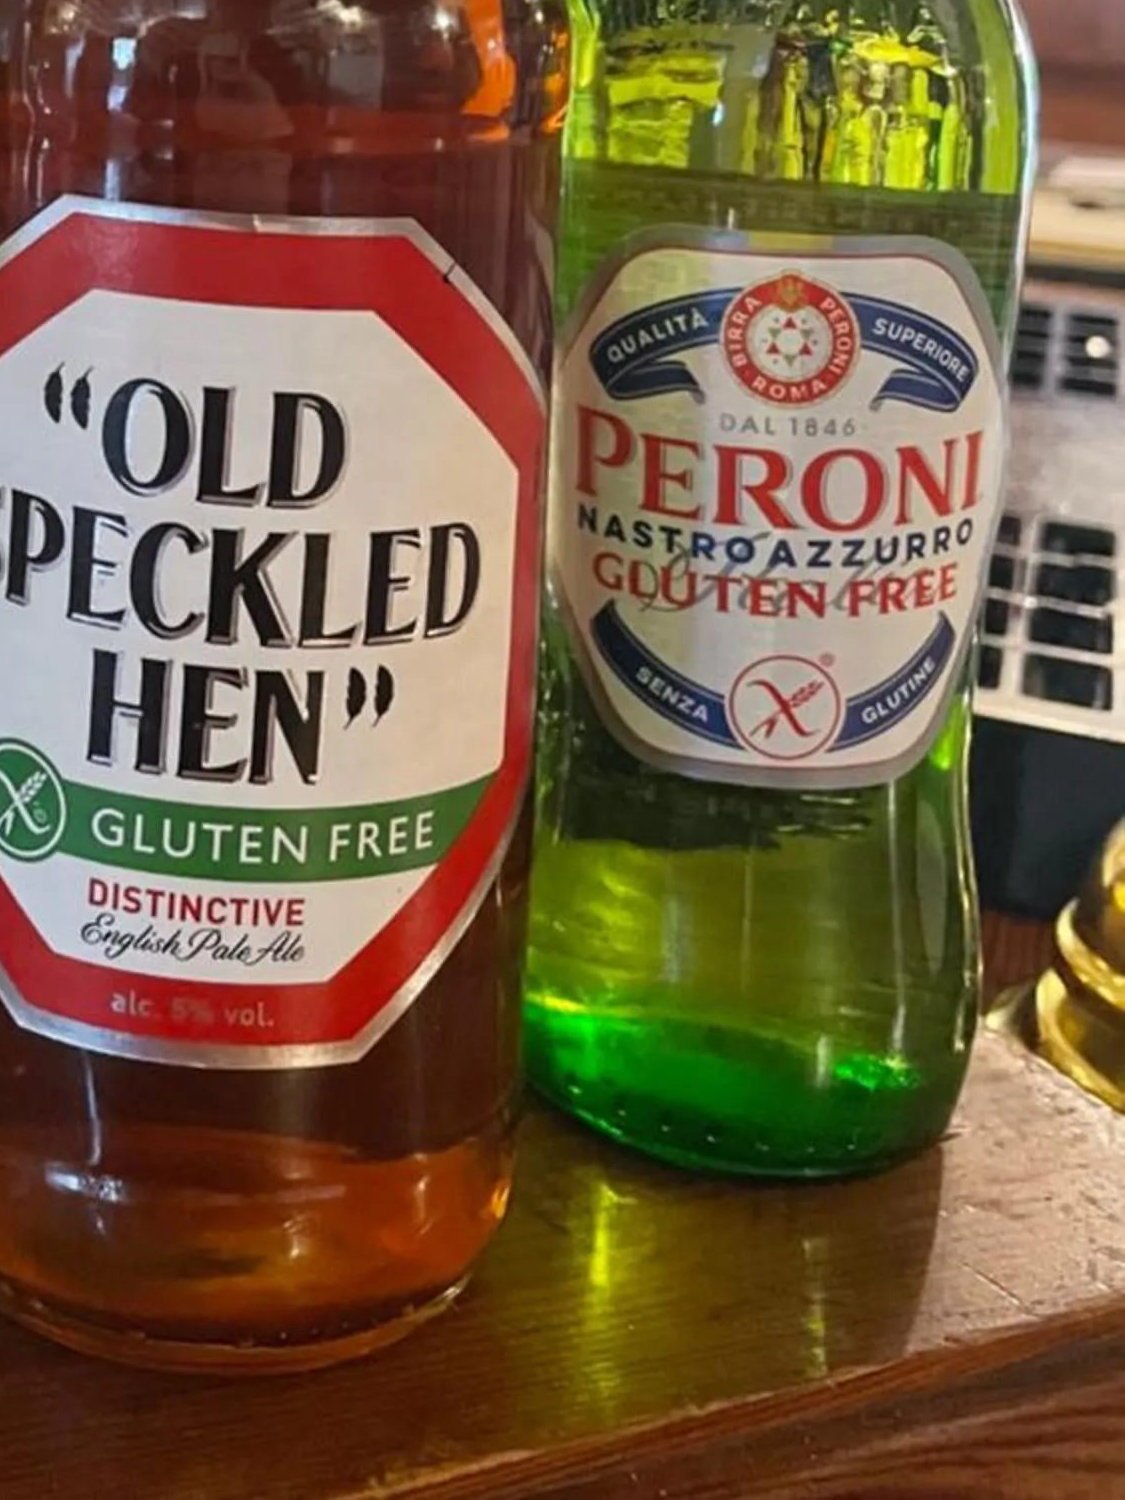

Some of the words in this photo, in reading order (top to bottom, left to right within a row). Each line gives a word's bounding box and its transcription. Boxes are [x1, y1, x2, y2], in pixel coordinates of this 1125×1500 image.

[727, 295, 763, 368] BIRRA
[819, 296, 853, 376] PERONI
[871, 317, 970, 383] SUPERIORE
[751, 375, 828, 401] ROMA
[719, 412, 776, 437] DAL
[789, 416, 856, 438] 1846
[575, 403, 985, 533] PERONI
[577, 502, 756, 564] NASTRO
[765, 518, 975, 569] AZZURRO
[592, 550, 827, 619] GLUTEN
[847, 562, 959, 618] FREE
[634, 665, 709, 723] SENZA
[860, 656, 937, 725] GLUTINE
[90, 807, 309, 865] GLUTEN
[329, 810, 435, 862] FREE
[88, 877, 305, 928] DISTINCTIVE
[80, 913, 182, 960] English
[177, 928, 251, 962] Pale
[243, 930, 306, 966] Ale
[224, 1001, 275, 1029] vol.
